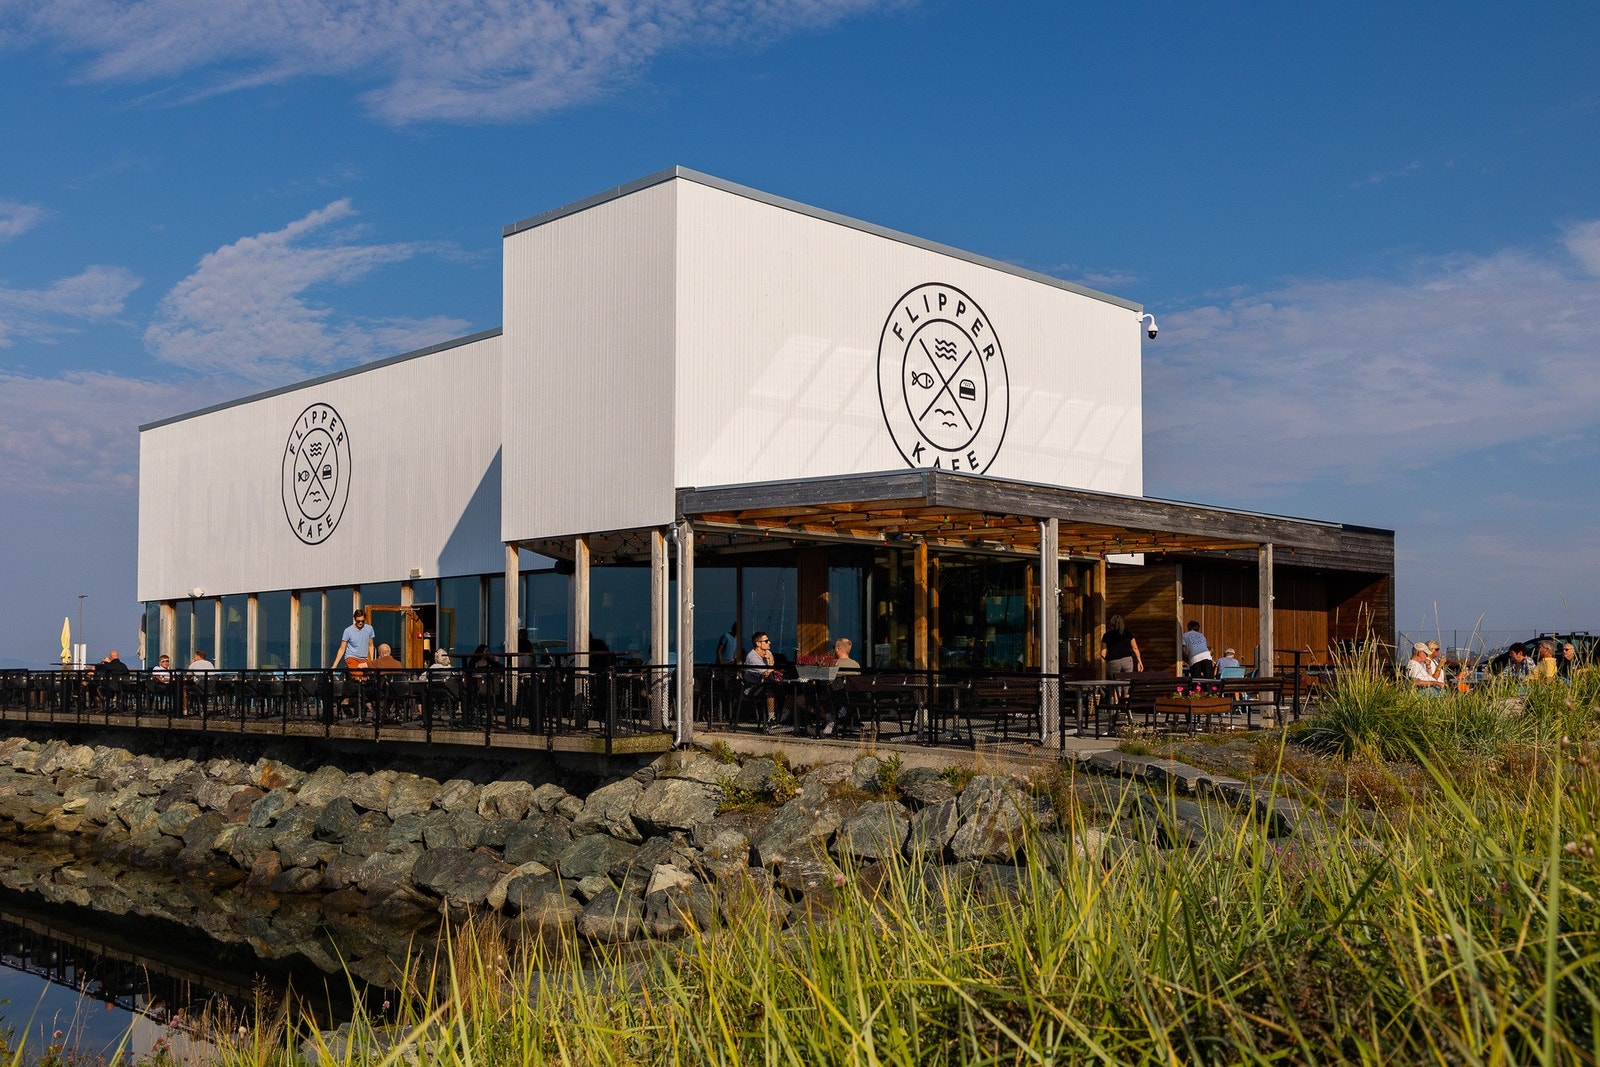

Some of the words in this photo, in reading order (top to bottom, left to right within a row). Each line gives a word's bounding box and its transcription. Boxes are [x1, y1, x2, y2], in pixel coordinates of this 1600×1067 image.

[892, 292, 995, 361] FLIPPER
[289, 410, 343, 455] FLIPPER
[297, 514, 333, 538] KAFE
